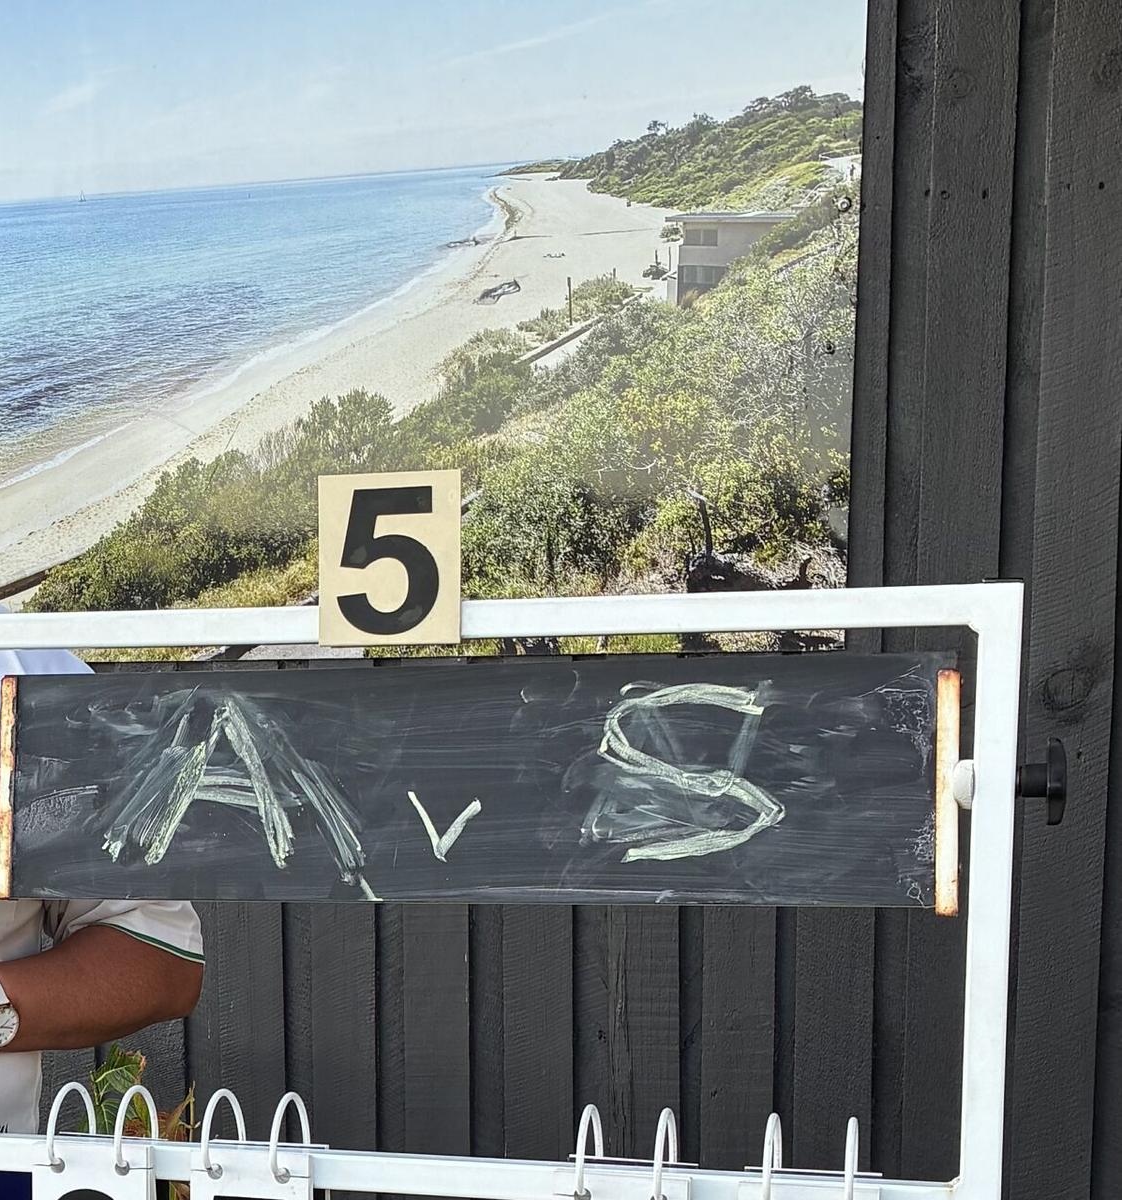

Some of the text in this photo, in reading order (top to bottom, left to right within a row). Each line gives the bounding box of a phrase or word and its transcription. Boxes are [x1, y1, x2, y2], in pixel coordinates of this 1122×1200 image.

[336, 485, 440, 636] 5
[100, 685, 368, 885] A
[594, 680, 787, 864] S
